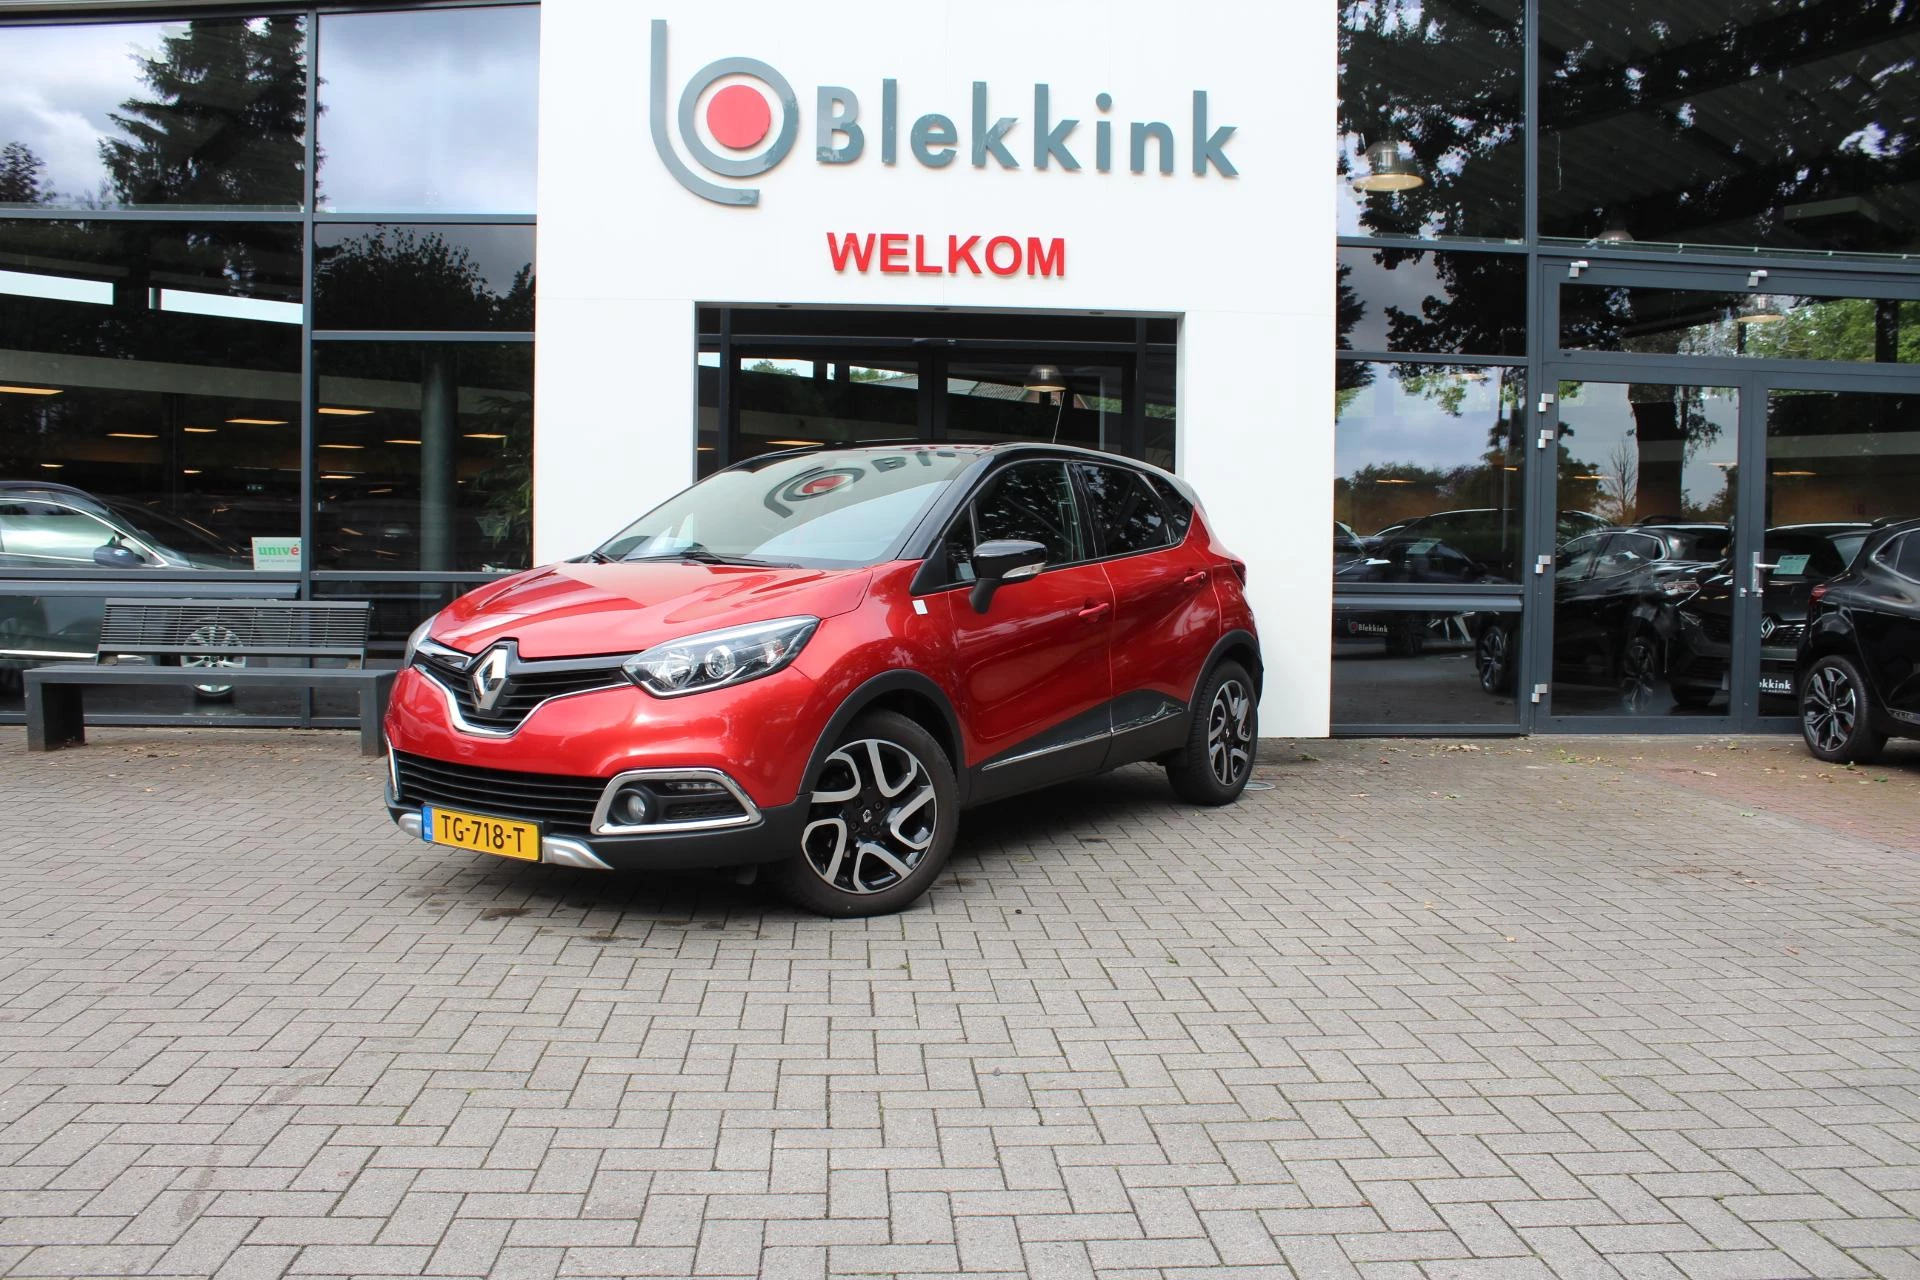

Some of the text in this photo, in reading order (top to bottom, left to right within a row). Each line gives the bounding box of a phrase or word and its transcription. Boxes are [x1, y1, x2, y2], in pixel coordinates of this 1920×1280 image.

[816, 78, 1239, 177] Blekkink
[826, 232, 1065, 277] WELKOM
[441, 814, 525, 853] TG-718-T
